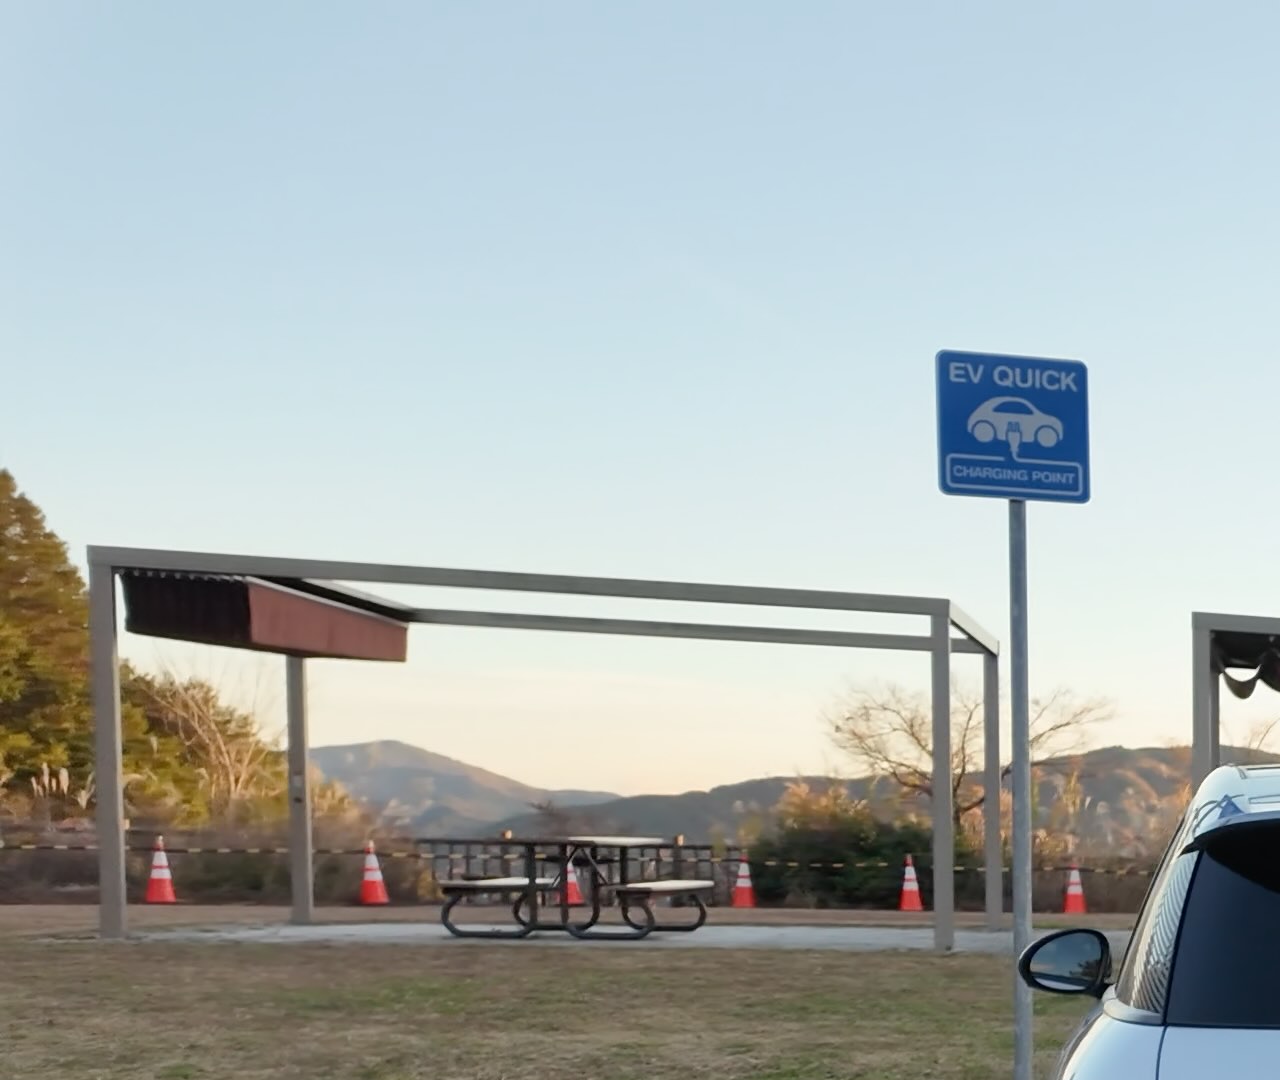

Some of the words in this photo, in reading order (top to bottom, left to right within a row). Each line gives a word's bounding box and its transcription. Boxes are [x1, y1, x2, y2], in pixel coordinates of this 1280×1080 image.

[949, 362, 984, 384] EV
[993, 366, 1077, 392] QUICK
[953, 465, 1028, 481] CHARGING
[1032, 471, 1076, 485] POINT
